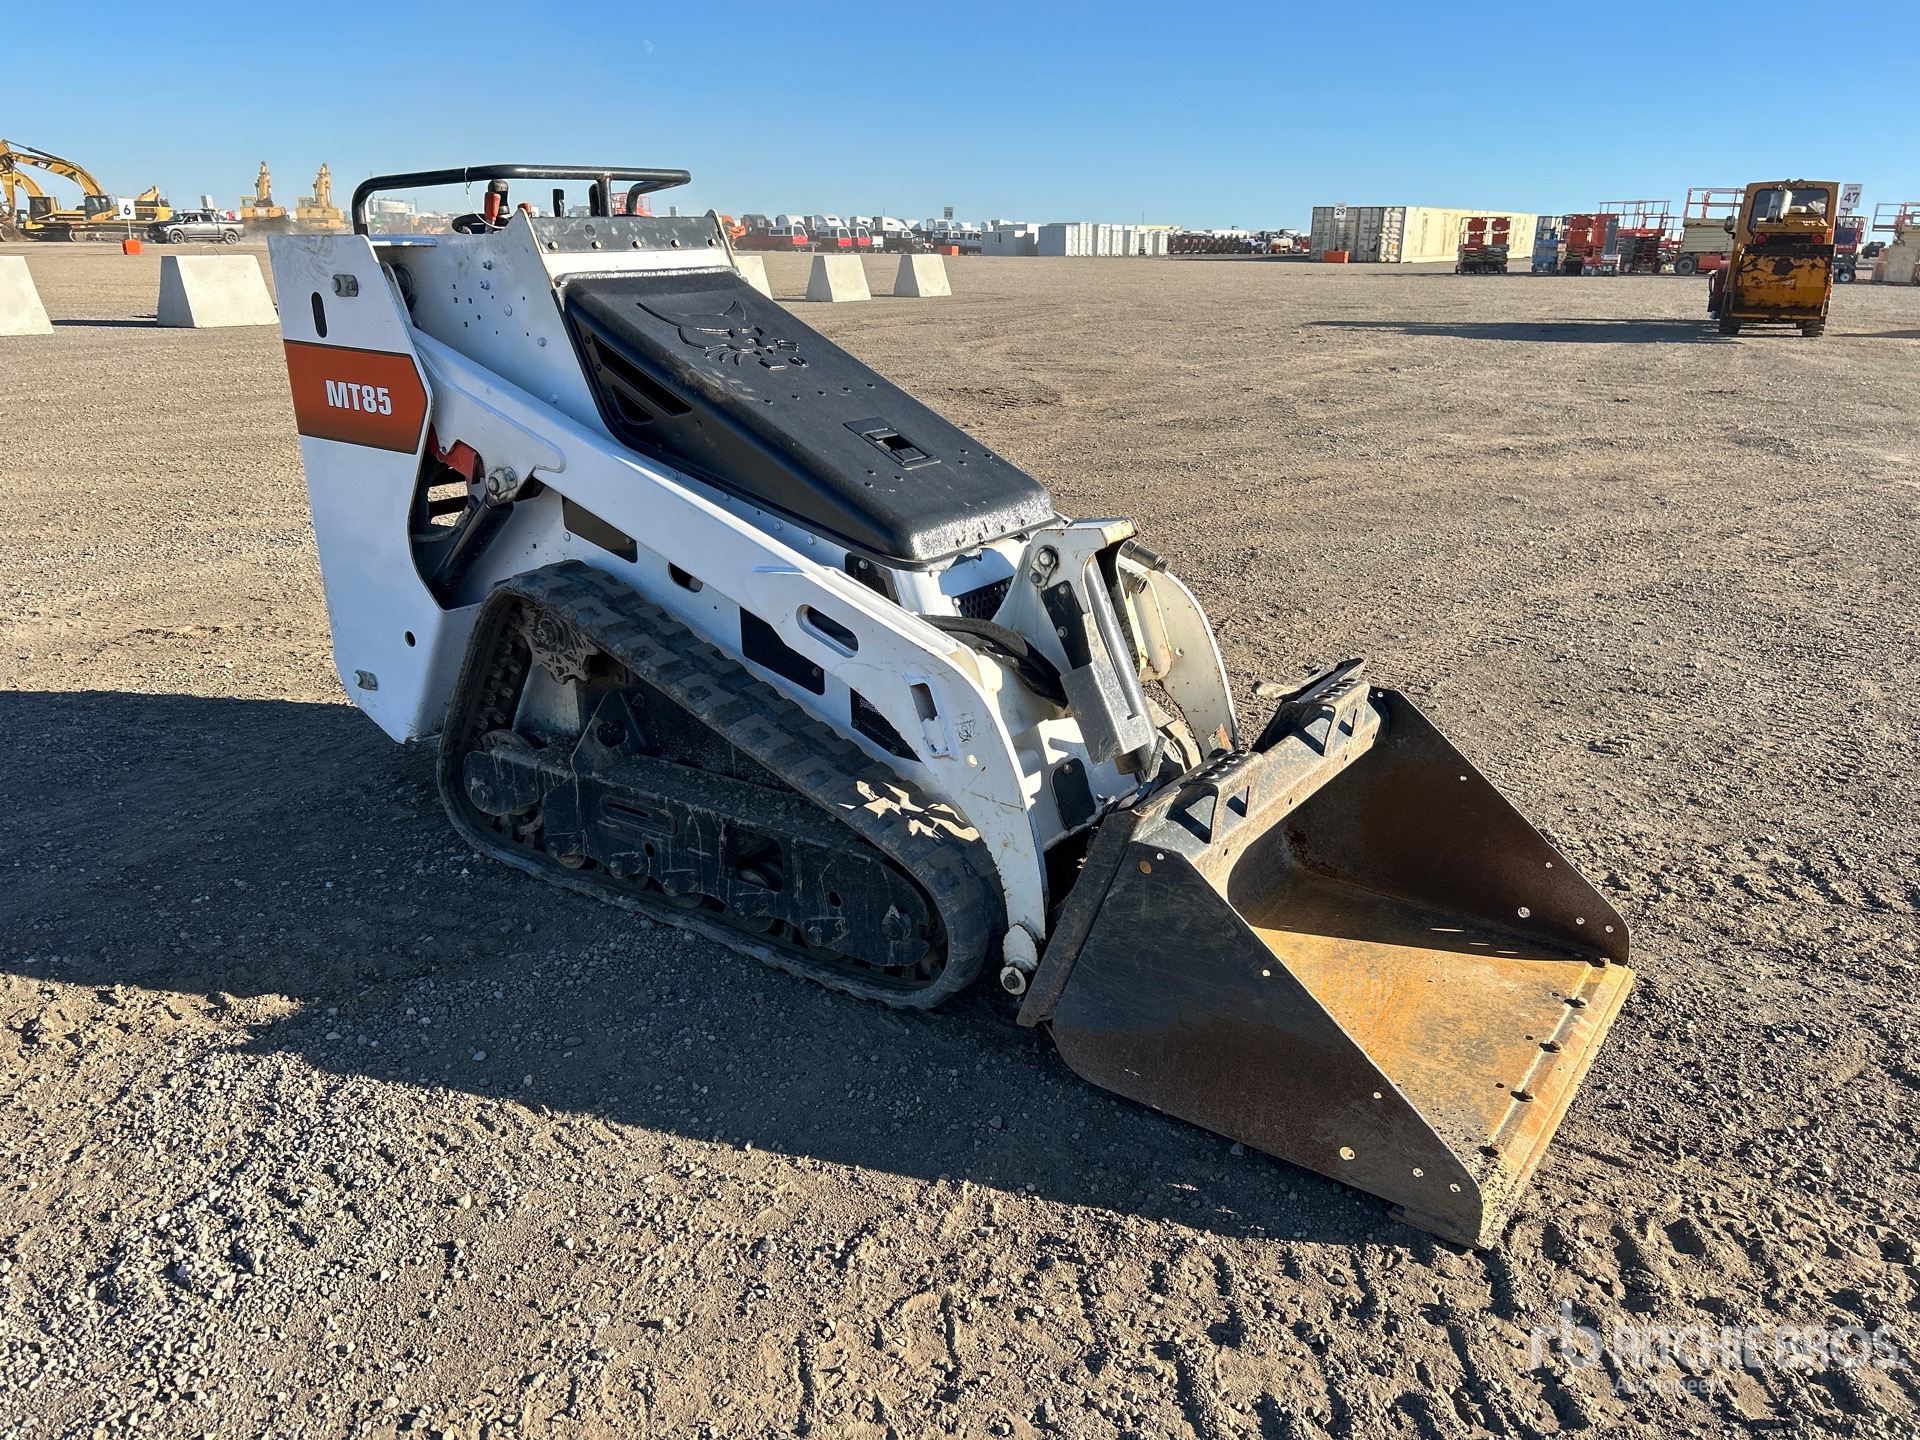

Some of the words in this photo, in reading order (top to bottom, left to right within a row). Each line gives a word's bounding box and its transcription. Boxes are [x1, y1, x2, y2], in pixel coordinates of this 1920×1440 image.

[1843, 192, 1860, 203] 47
[123, 204, 131, 215] 6
[1336, 208, 1345, 216] 29
[325, 380, 392, 416] MT85
